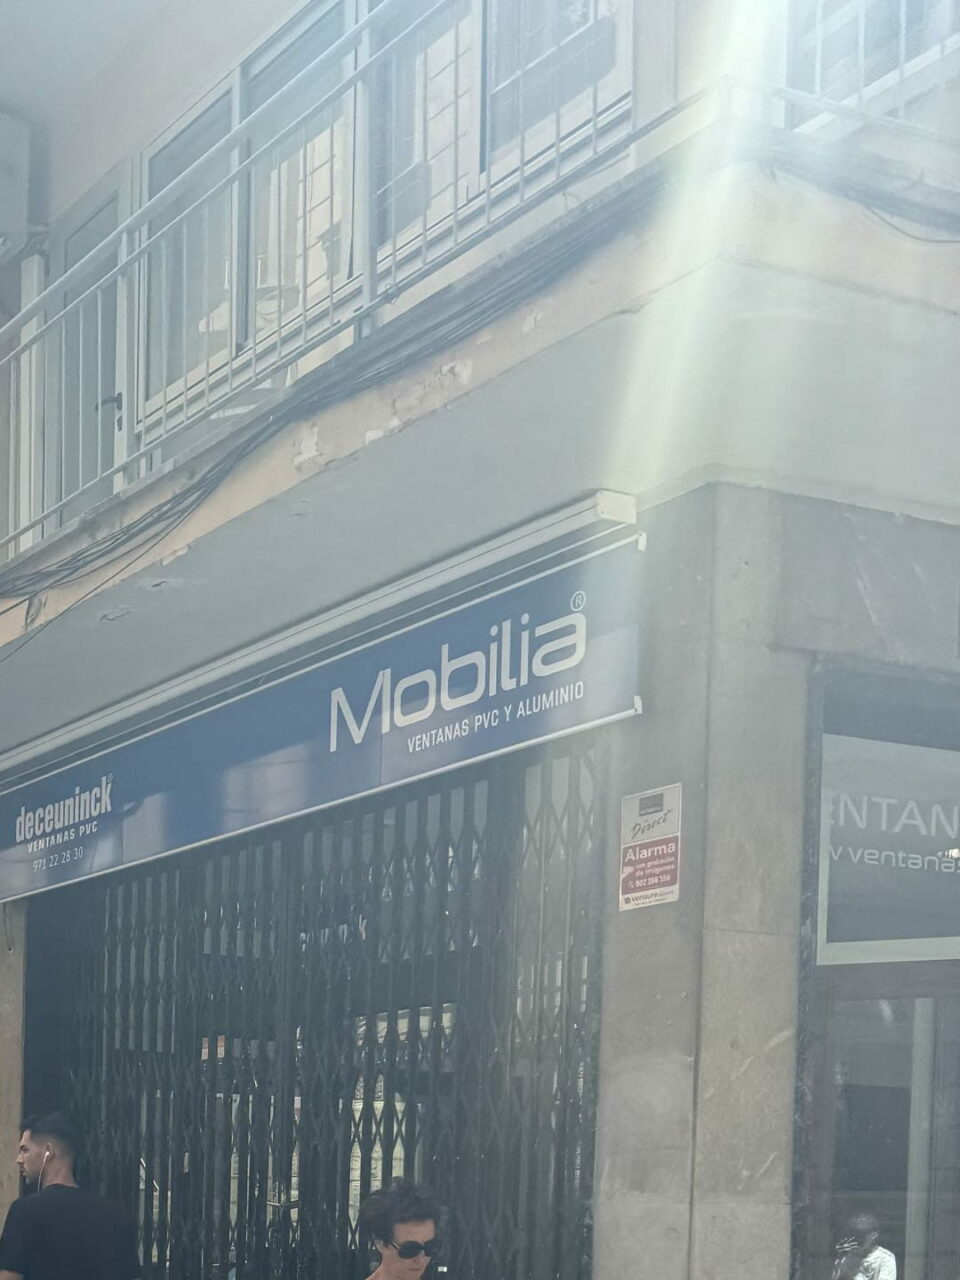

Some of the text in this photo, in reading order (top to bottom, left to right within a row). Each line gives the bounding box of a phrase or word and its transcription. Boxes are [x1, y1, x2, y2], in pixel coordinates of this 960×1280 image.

[330, 612, 587, 752] Mobilia
[407, 681, 585, 753] VENTANAS PVC Y ALUMINIO
[15, 775, 113, 843] deceuninck
[27, 821, 98, 854] VENTANAS PVC
[624, 842, 676, 862] Alarma
[49, 854, 59, 867] 22
[61, 850, 71, 864] 28
[73, 846, 83, 860] 30
[847, 847, 960, 873] ventana
